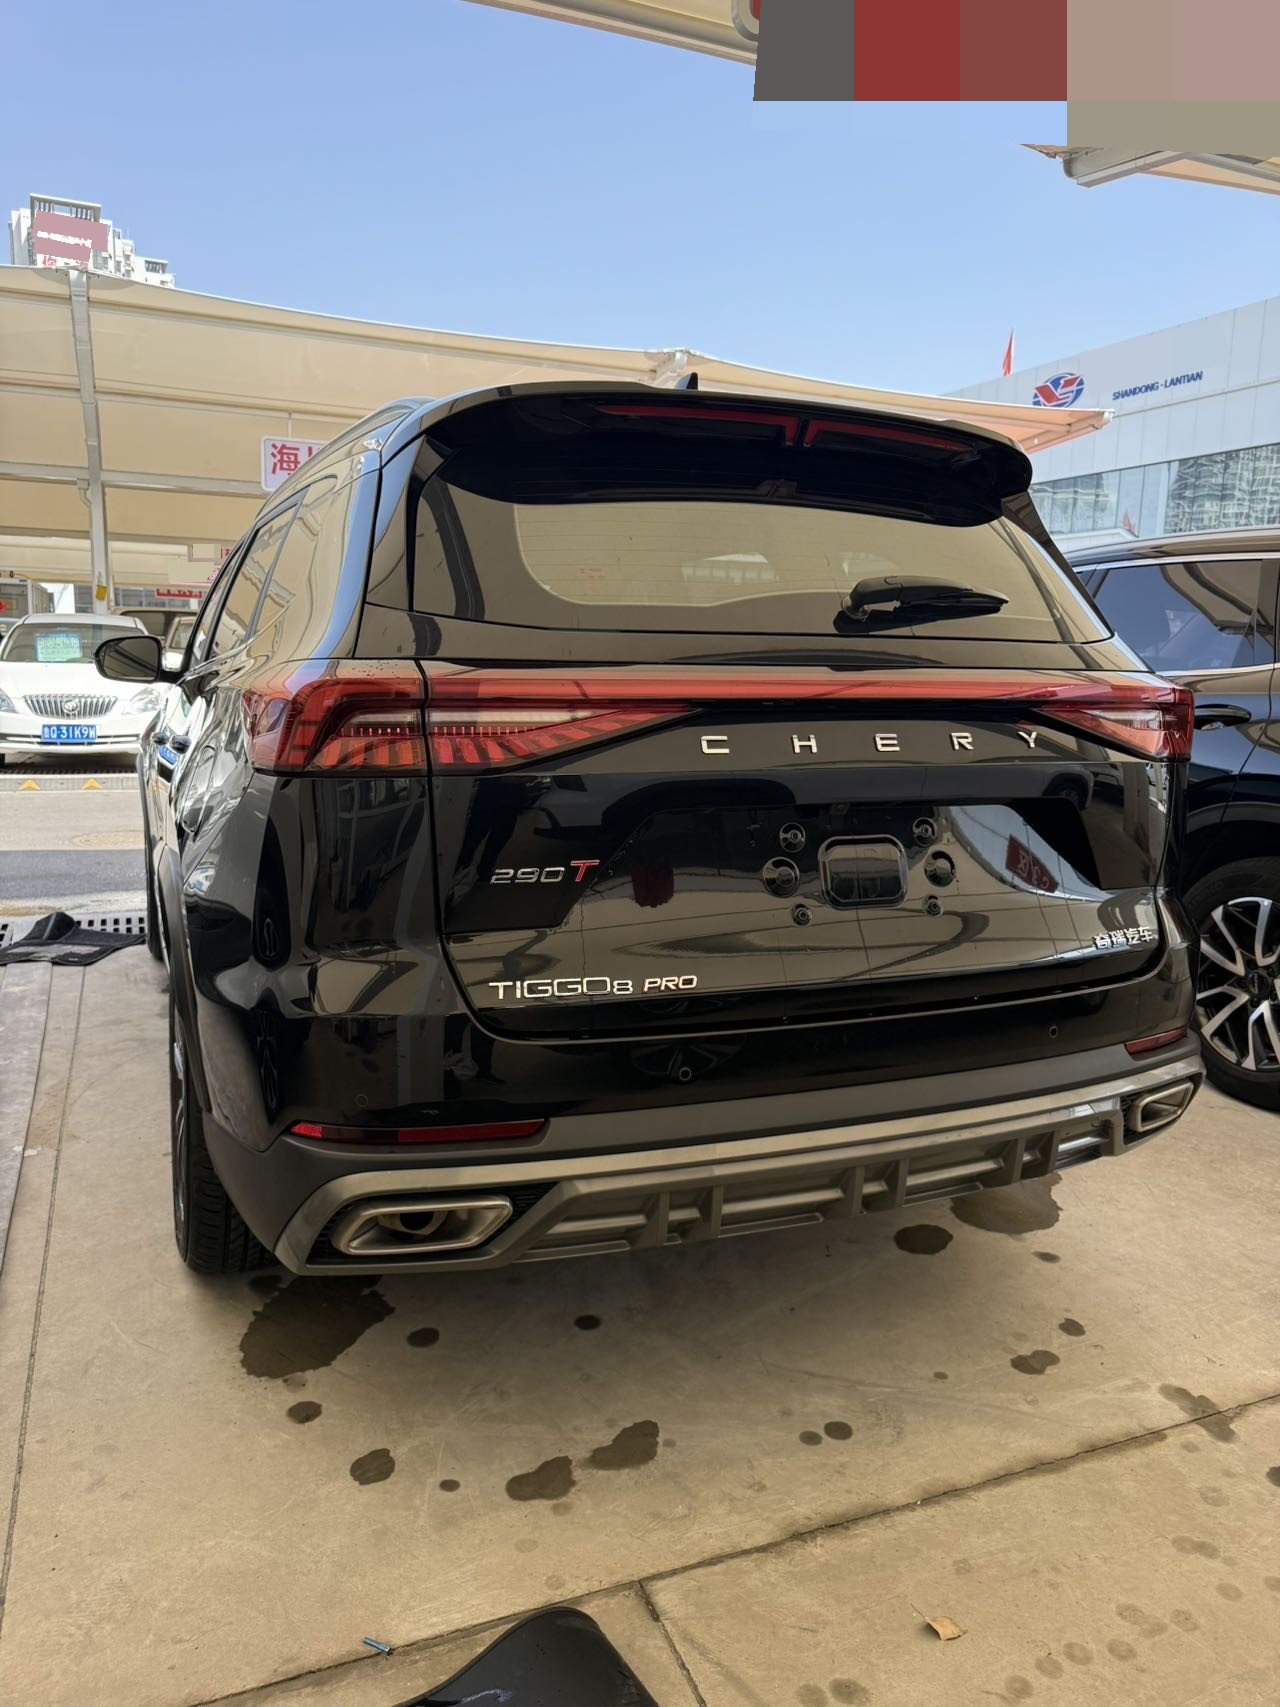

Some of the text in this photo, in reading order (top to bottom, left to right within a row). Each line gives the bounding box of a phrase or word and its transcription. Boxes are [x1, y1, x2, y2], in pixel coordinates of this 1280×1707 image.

[271, 443, 313, 475] 海
[701, 731, 1038, 754] CHERY
[642, 975, 698, 992] PRO
